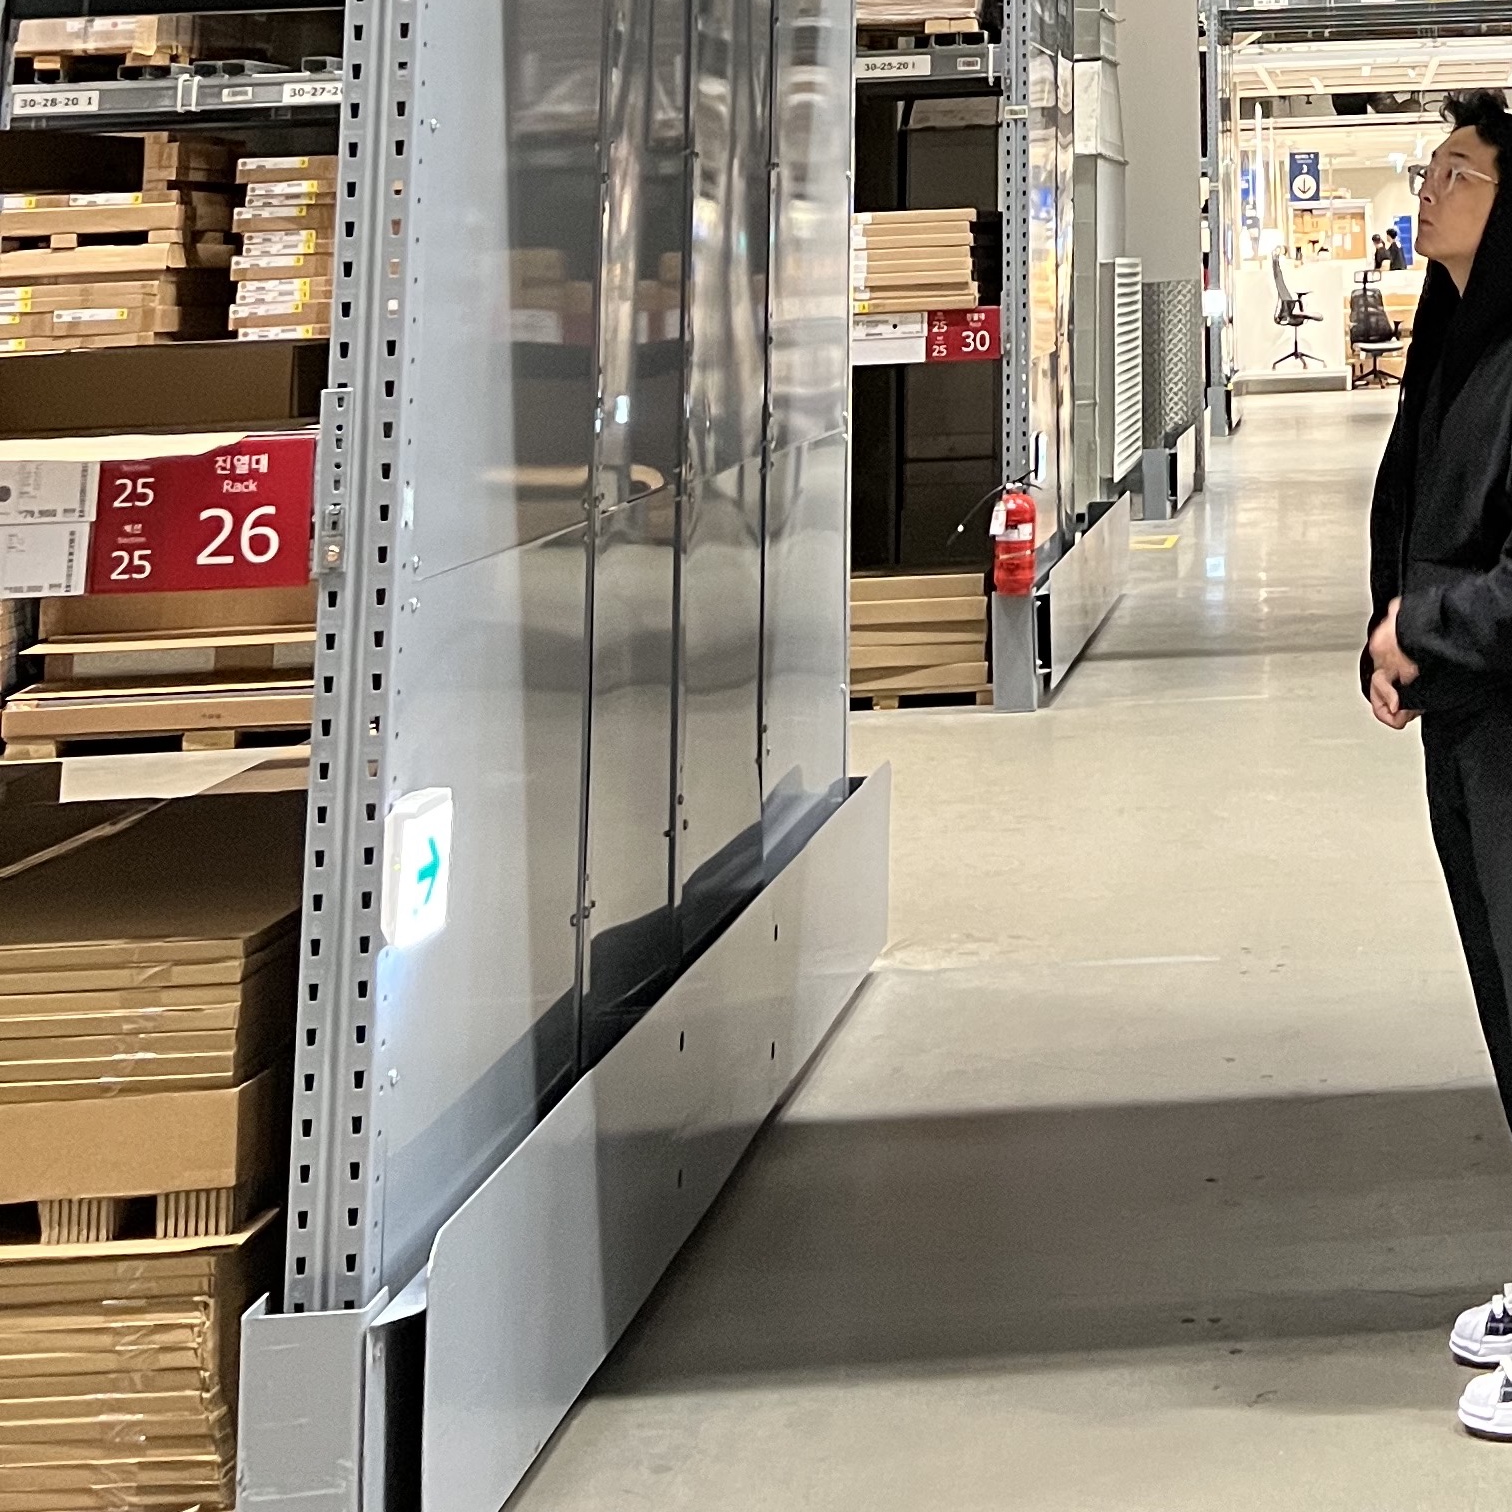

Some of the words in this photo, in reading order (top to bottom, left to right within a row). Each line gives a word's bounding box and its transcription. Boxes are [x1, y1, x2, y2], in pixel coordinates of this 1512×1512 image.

[290, 86, 343, 97] 30-27-2
[932, 321, 947, 333] 25
[932, 345, 947, 357] 25
[961, 330, 990, 352] 30
[214, 453, 269, 474] 진열대
[112, 478, 155, 508] 25
[222, 479, 258, 493] Rack
[196, 505, 281, 565] 26
[110, 550, 152, 580] 25
